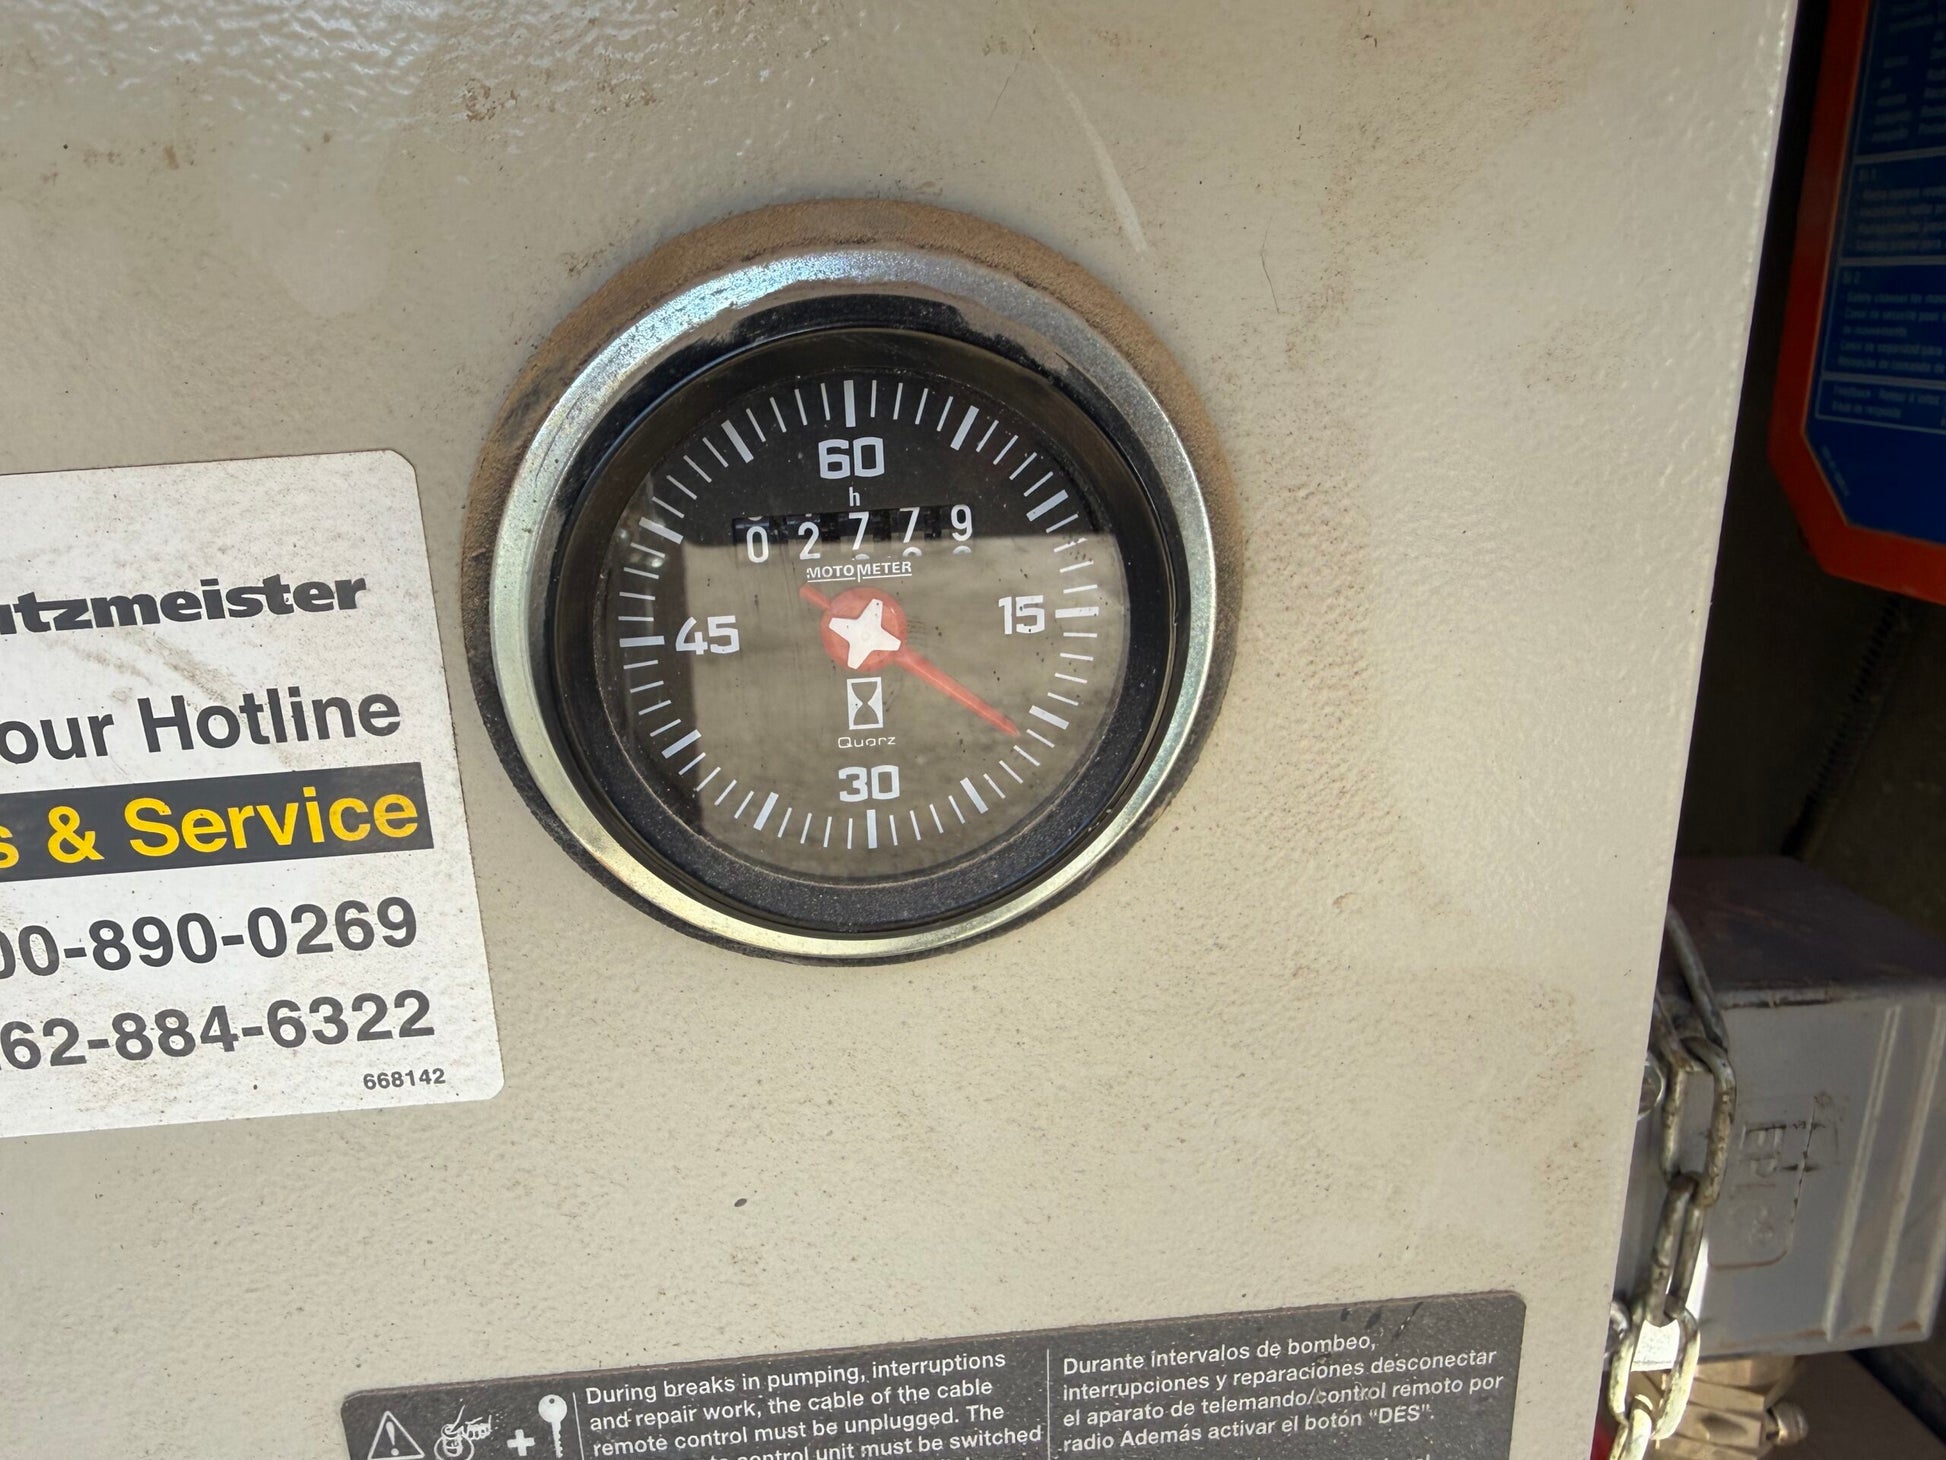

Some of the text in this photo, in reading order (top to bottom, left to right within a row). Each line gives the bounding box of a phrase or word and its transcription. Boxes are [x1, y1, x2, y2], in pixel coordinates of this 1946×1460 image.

[818, 436, 885, 480] 60
[849, 487, 861, 506] h
[675, 615, 740, 656] 45
[998, 595, 1046, 635] 15
[137, 685, 401, 754] Hotline
[838, 764, 900, 803] 30
[48, 805, 105, 864] &
[126, 786, 419, 857] Service
[362, 1066, 446, 1091] 668142
[1063, 1334, 1376, 1375] Durante intervalos de bombeo,
[1063, 1349, 1497, 1401] interrupciones y reparaciones desconectar
[586, 1353, 1006, 1405] During breaks in pumping, interruptions
[590, 1378, 993, 1431] and repair work, the cable of the cable
[1063, 1376, 1504, 1427] el aparato de telemando/control remoto por
[593, 1404, 1005, 1457] remote control must be unplugged. The
[816, 1443, 854, 1460] unit
[861, 1438, 913, 1456] must
[919, 1436, 943, 1452] be
[950, 1425, 1042, 1449] switched
[1063, 1433, 1115, 1452] radio
[1120, 1424, 1202, 1447] Además
[1208, 1420, 1276, 1440] activar
[1281, 1415, 1298, 1433] el
[1305, 1409, 1362, 1431] botón
